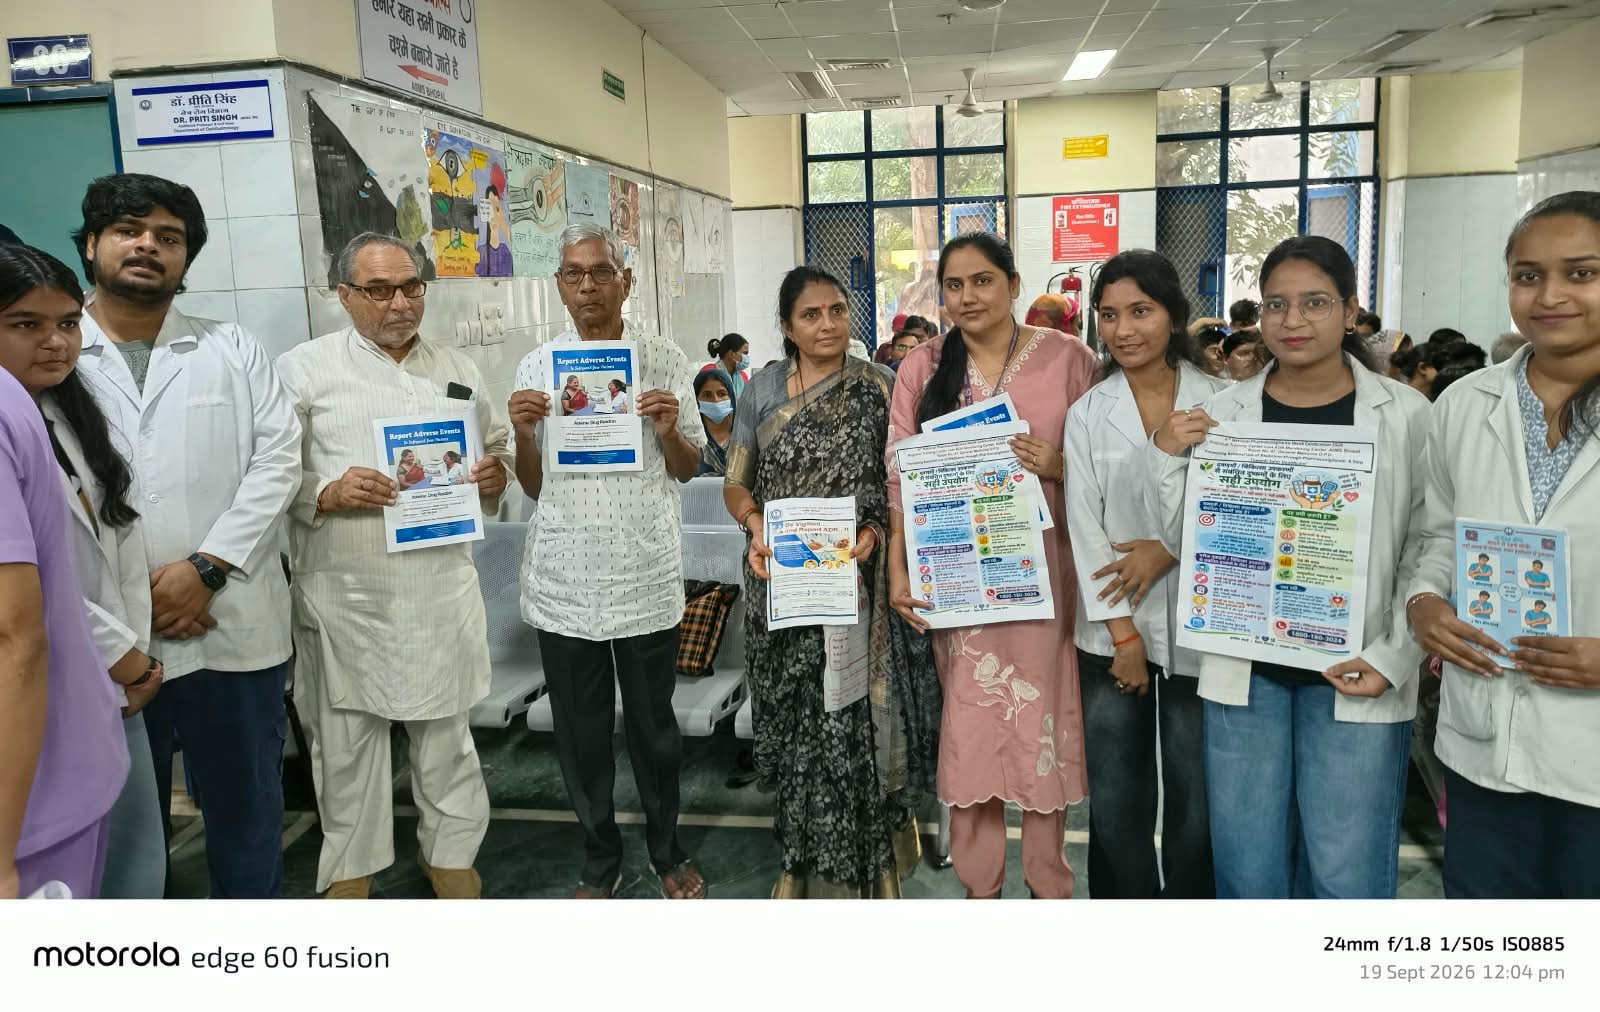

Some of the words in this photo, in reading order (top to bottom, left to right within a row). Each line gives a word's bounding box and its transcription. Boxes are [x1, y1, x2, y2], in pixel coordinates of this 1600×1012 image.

[416, 11, 434, 36] सभी
[436, 20, 458, 46] प्रकार
[458, 28, 466, 48] के
[388, 34, 408, 59] चश्मे
[410, 44, 433, 69] बनाये
[434, 52, 451, 76] जाते
[452, 56, 459, 80] है
[171, 96, 186, 106] डॉ.
[188, 94, 212, 106] प्रीति
[214, 92, 237, 104] सिंह
[984, 414, 1006, 424] Events
[924, 480, 940, 488] सही
[942, 476, 968, 486] उपयोग
[1219, 474, 1241, 484] सही
[1244, 476, 1282, 488] उपयोग
[1278, 471, 1291, 480] लिए
